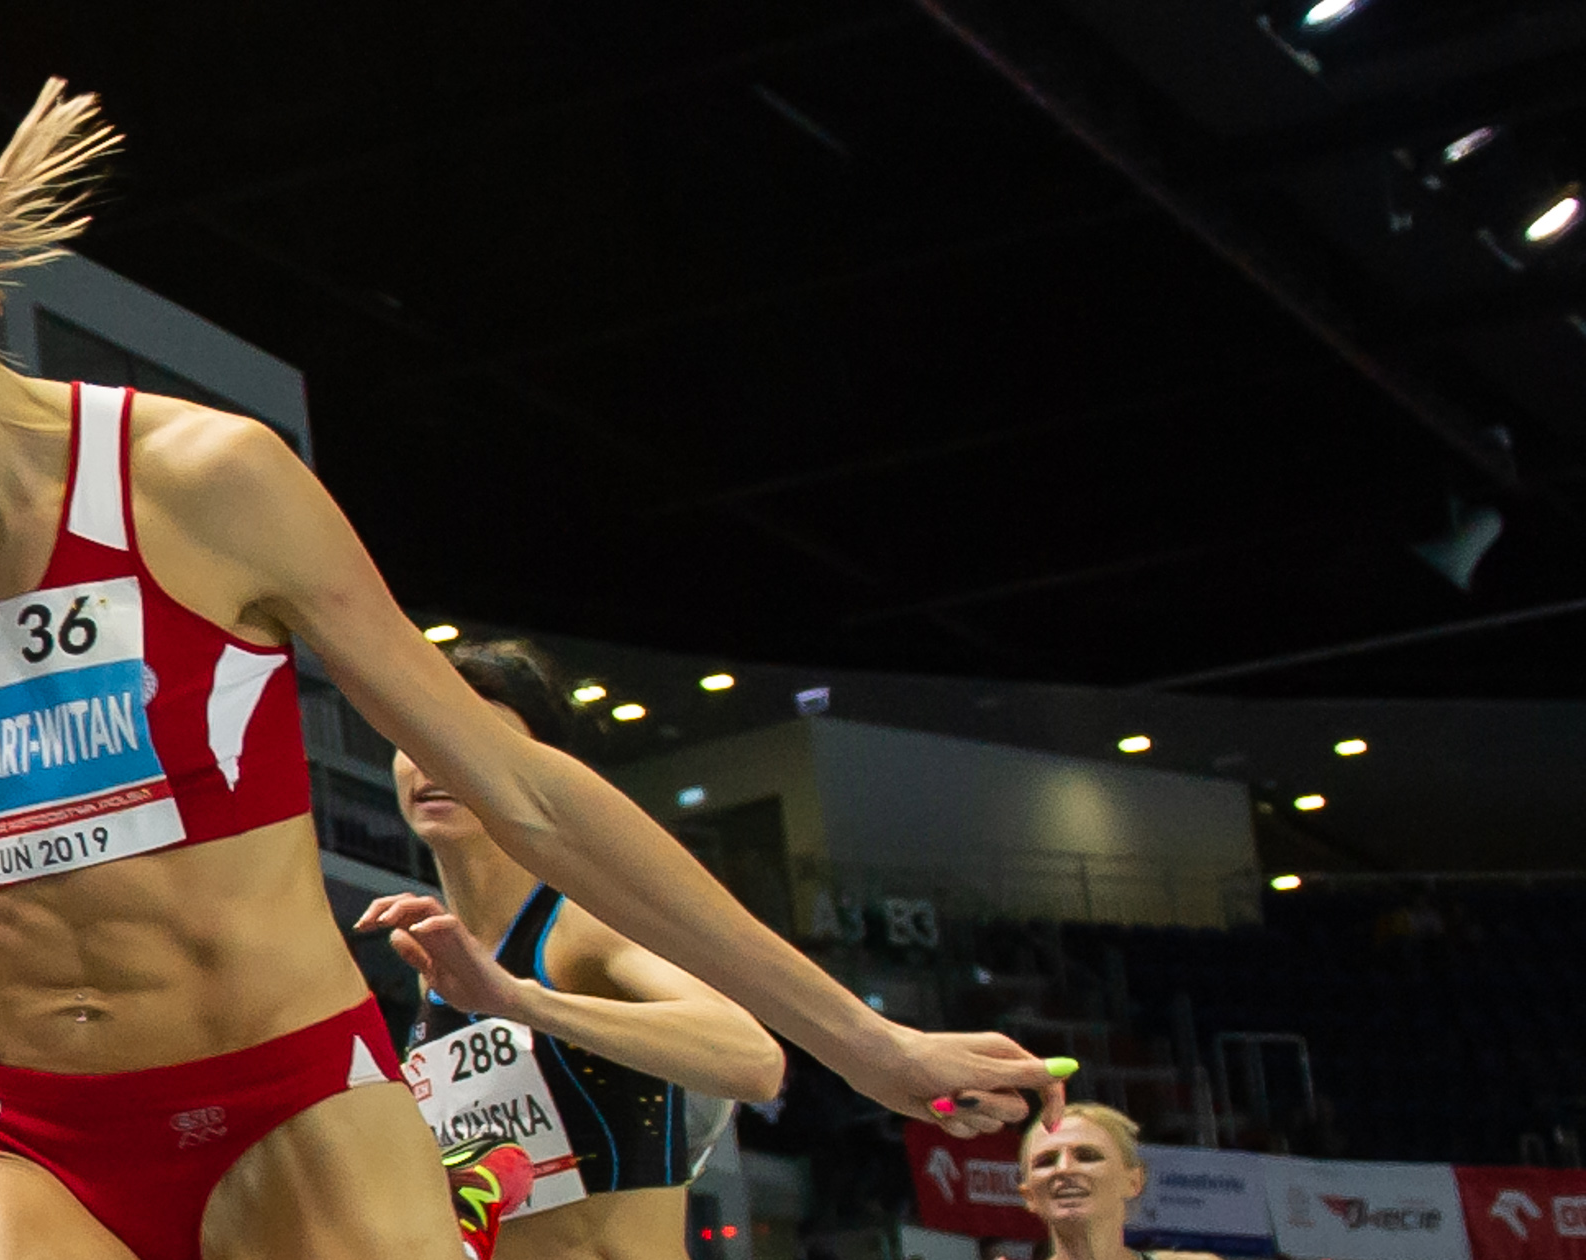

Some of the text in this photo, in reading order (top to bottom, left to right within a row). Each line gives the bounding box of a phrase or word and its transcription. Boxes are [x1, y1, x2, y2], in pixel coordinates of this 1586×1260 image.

[18, 596, 98, 663] 36
[38, 826, 109, 868] 2019
[884, 897, 939, 947] B3
[449, 1025, 518, 1084] 288
[430, 1094, 554, 1147] ASIŃSKA
